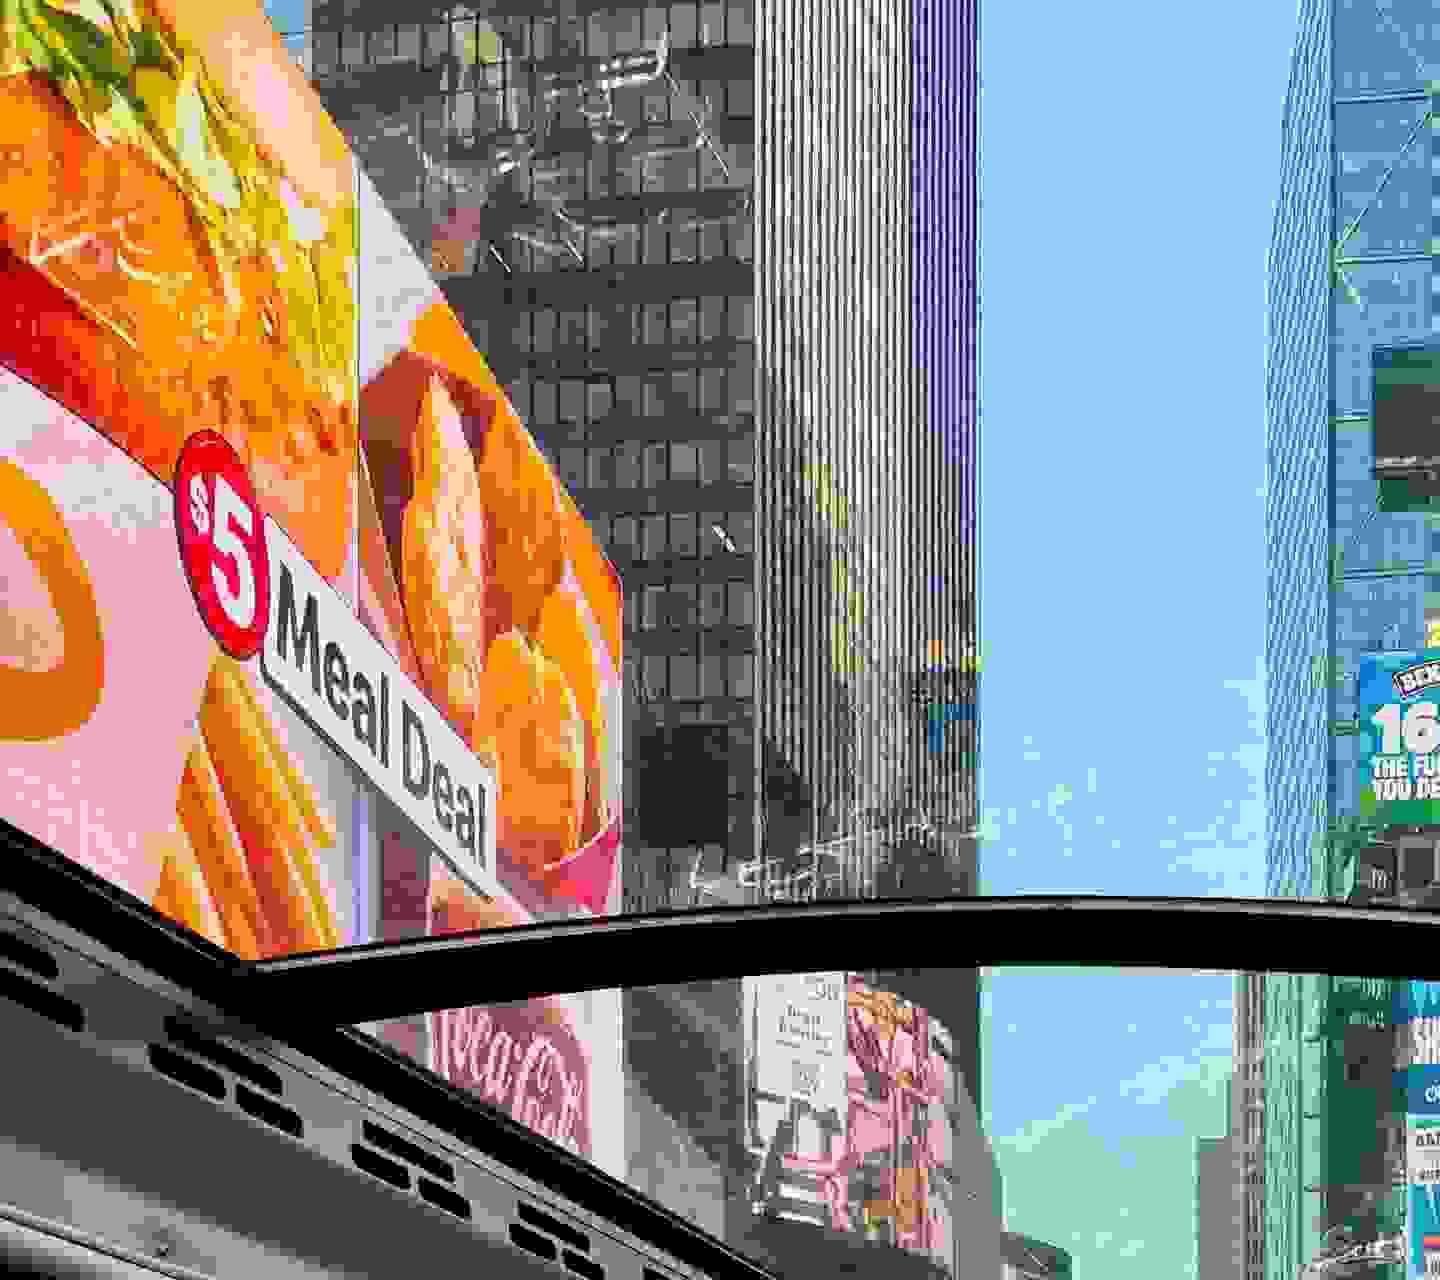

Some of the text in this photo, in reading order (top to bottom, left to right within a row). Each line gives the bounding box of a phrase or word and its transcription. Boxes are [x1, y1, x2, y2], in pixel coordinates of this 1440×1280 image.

[190, 476, 258, 632] $5
[278, 560, 488, 872] Meal Deal
[1371, 702, 1440, 753] 16
[1374, 756, 1409, 778] THE
[1374, 778, 1412, 800] YOU
